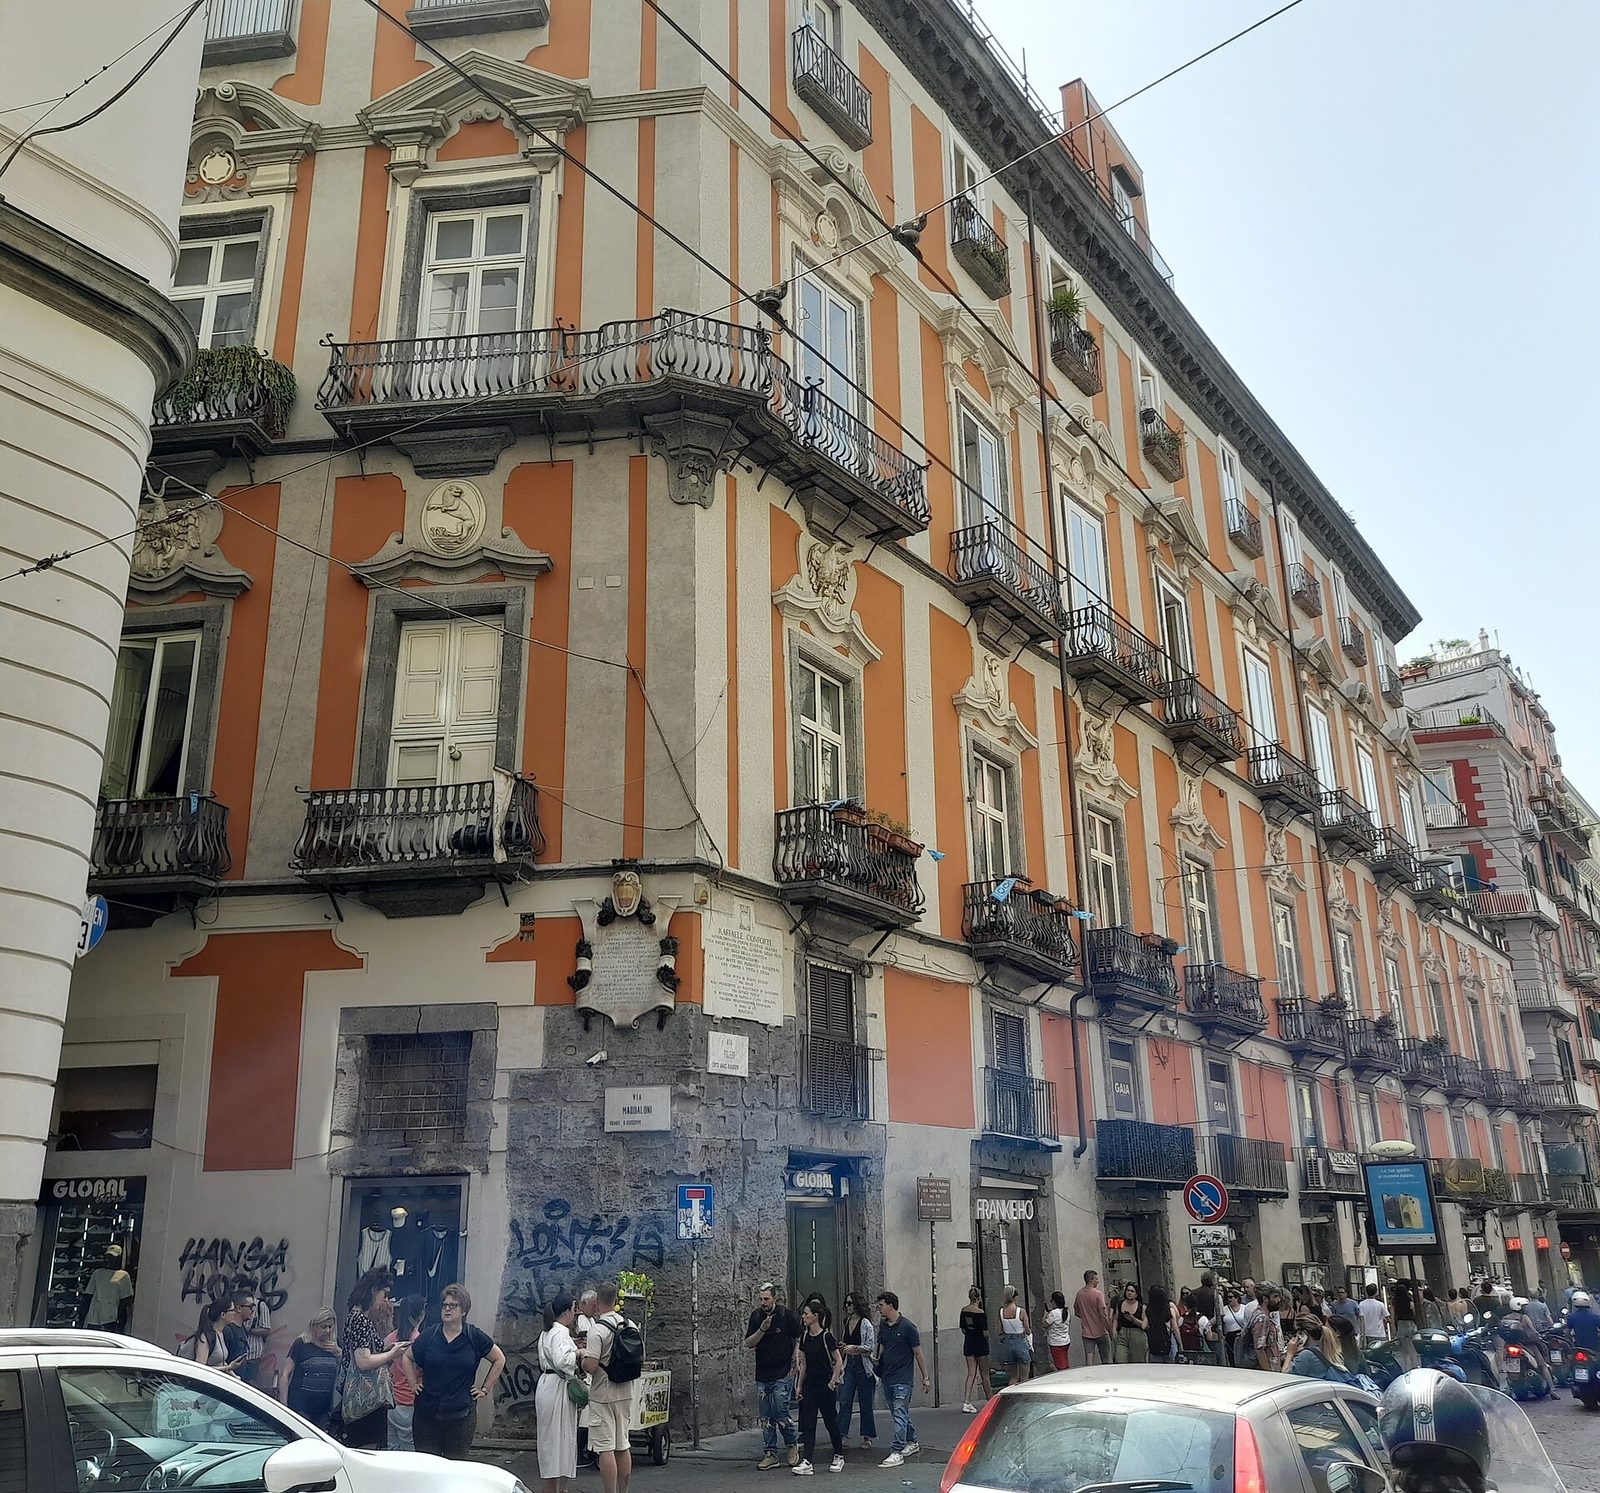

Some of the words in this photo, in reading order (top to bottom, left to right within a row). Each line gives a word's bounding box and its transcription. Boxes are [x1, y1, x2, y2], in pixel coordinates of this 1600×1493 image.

[1114, 1082, 1130, 1095] GAIA
[632, 1093, 642, 1101] VIA
[622, 1105, 653, 1115] MADDALONI
[1213, 1101, 1227, 1113] GAIA
[796, 1171, 834, 1189] GLOBAL
[52, 1178, 128, 1198] GLOBAL
[179, 1236, 290, 1272] HANSA
